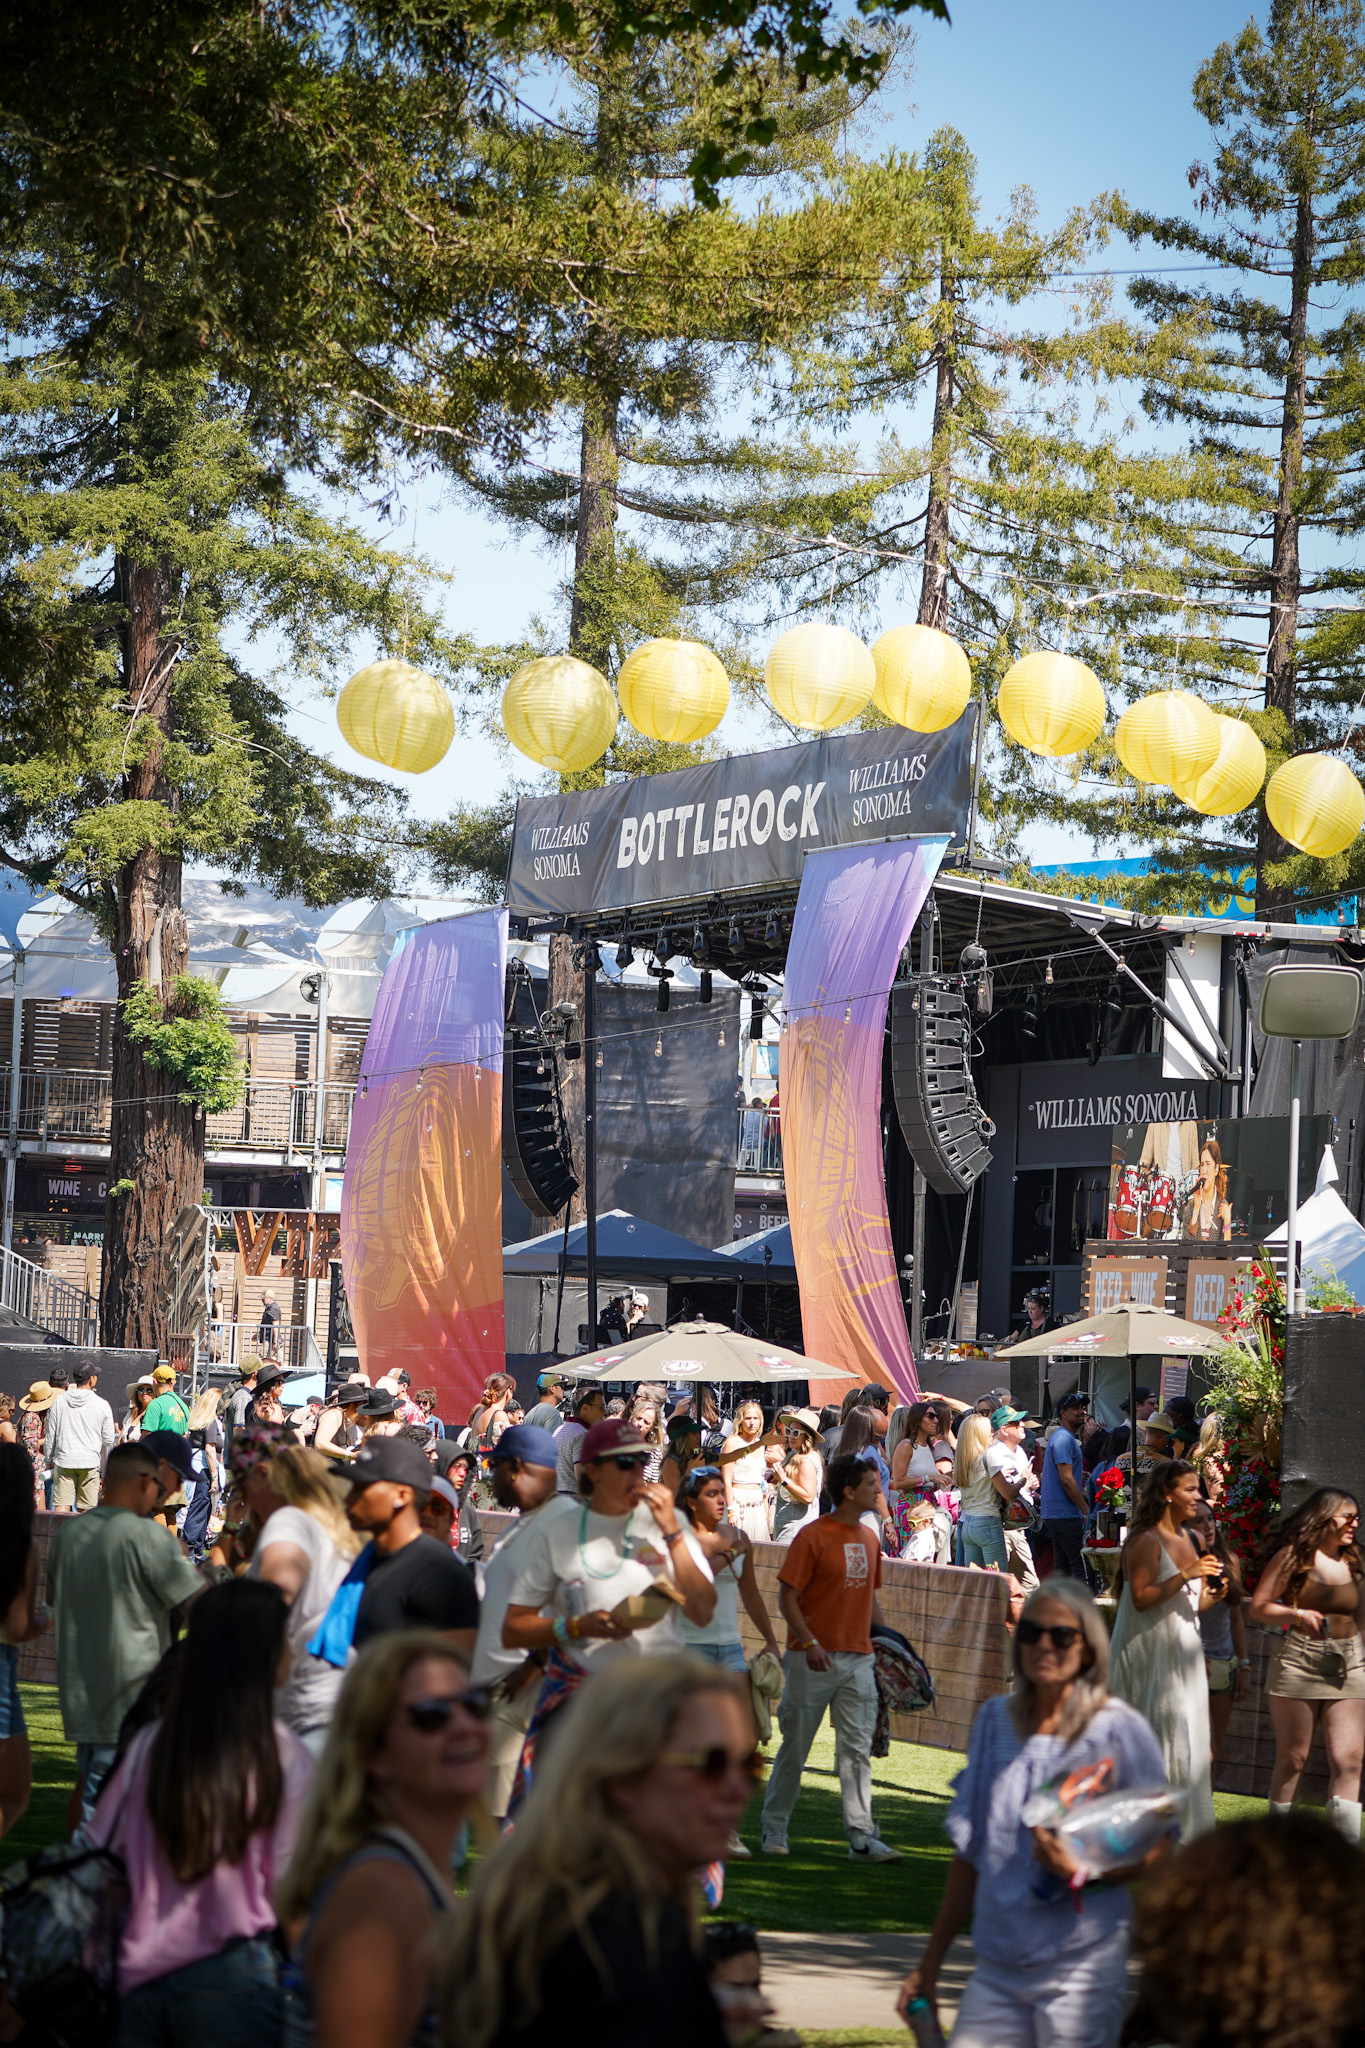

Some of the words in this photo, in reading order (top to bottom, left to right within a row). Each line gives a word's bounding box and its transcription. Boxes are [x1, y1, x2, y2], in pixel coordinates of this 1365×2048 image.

[848, 753, 928, 796] WILLIAMS
[616, 781, 827, 869] BOTTLEROCK
[852, 789, 911, 827] SONOMA
[530, 822, 591, 852] WILLIAMS
[533, 853, 581, 881] SONOMA
[1035, 1095, 1122, 1130] WILLIAMS
[1124, 1090, 1199, 1124] SONOMA
[48, 1179, 81, 1197] WINE
[233, 1210, 342, 1279] VIP
[1094, 1271, 1122, 1315] BEER
[1193, 1274, 1225, 1322] BEER
